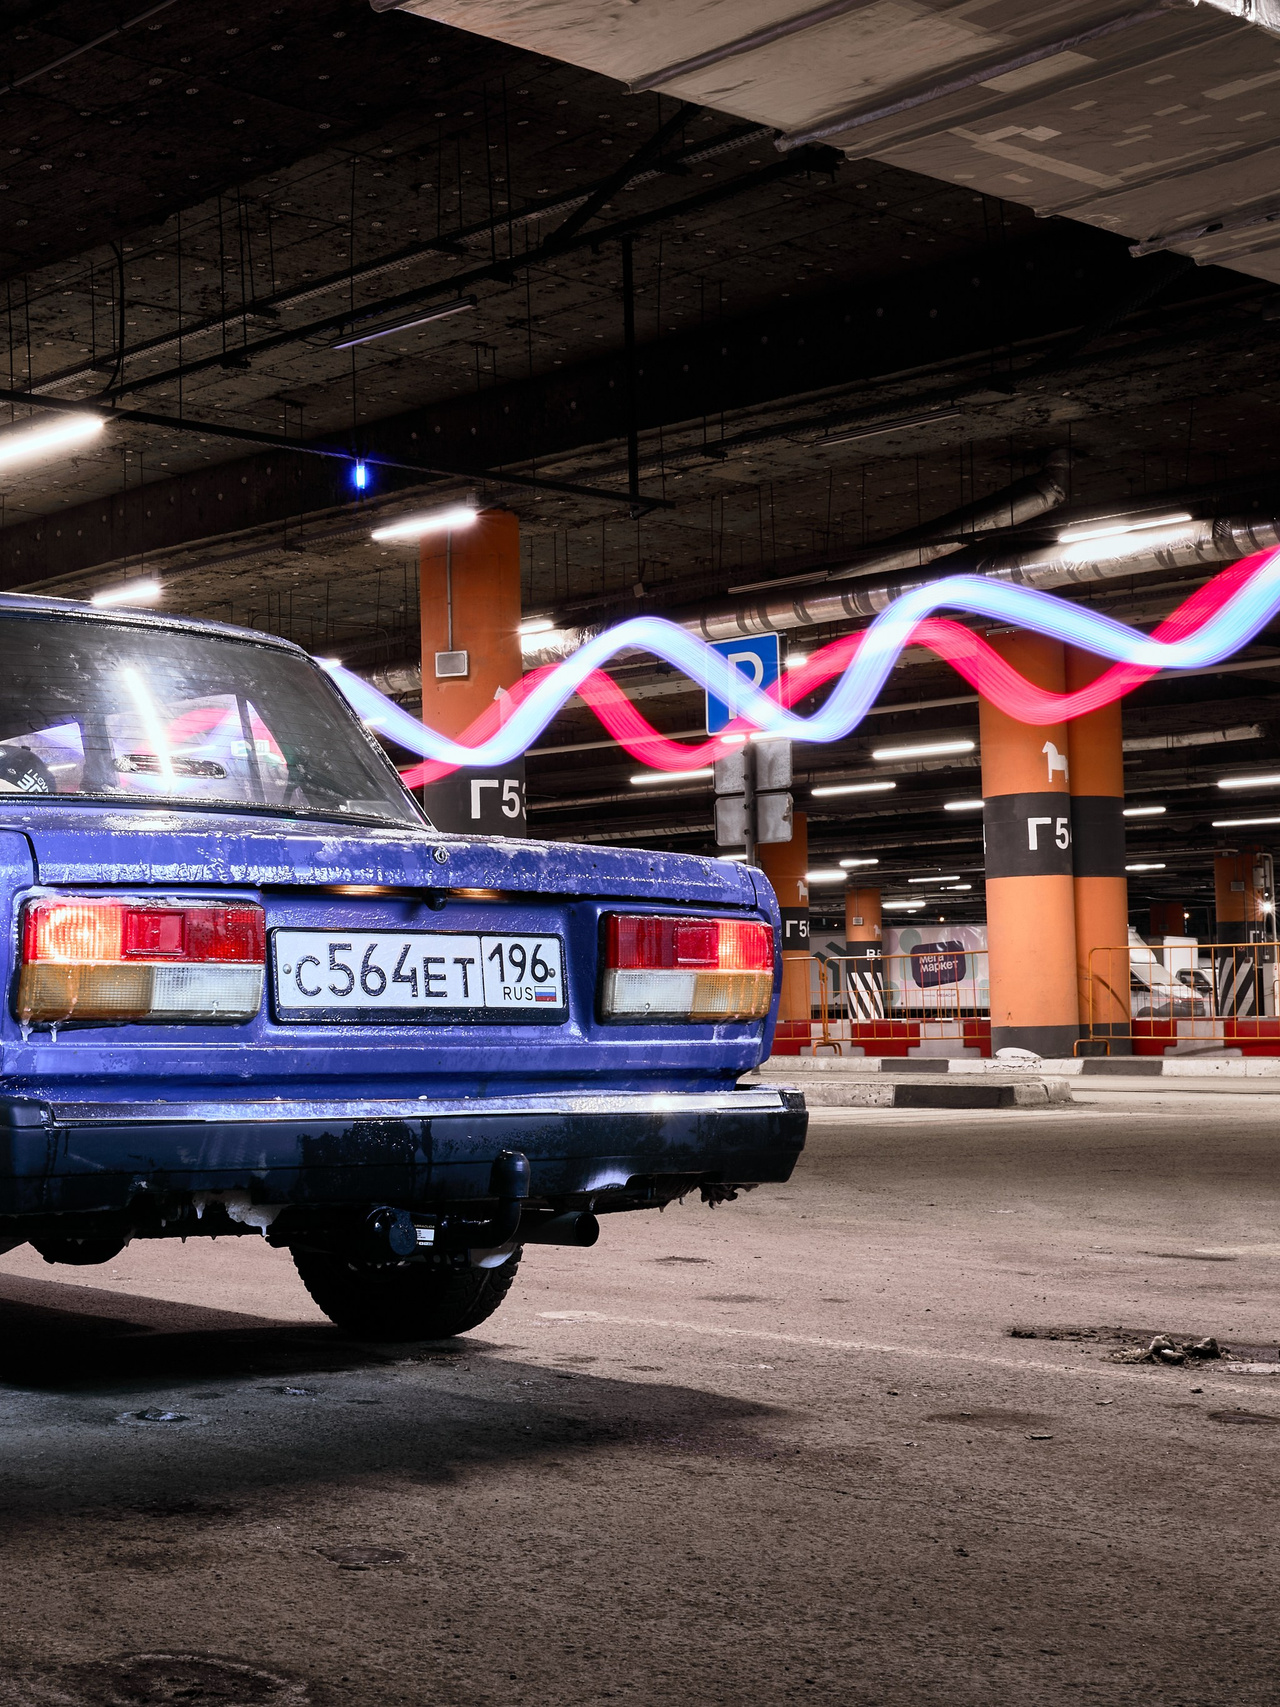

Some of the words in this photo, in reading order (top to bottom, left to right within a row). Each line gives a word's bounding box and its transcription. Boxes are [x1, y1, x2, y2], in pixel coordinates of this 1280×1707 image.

[470, 779, 527, 820] Г5
[1027, 817, 1072, 851] Г5
[488, 943, 550, 983] 196
[503, 986, 533, 1001] RUS
